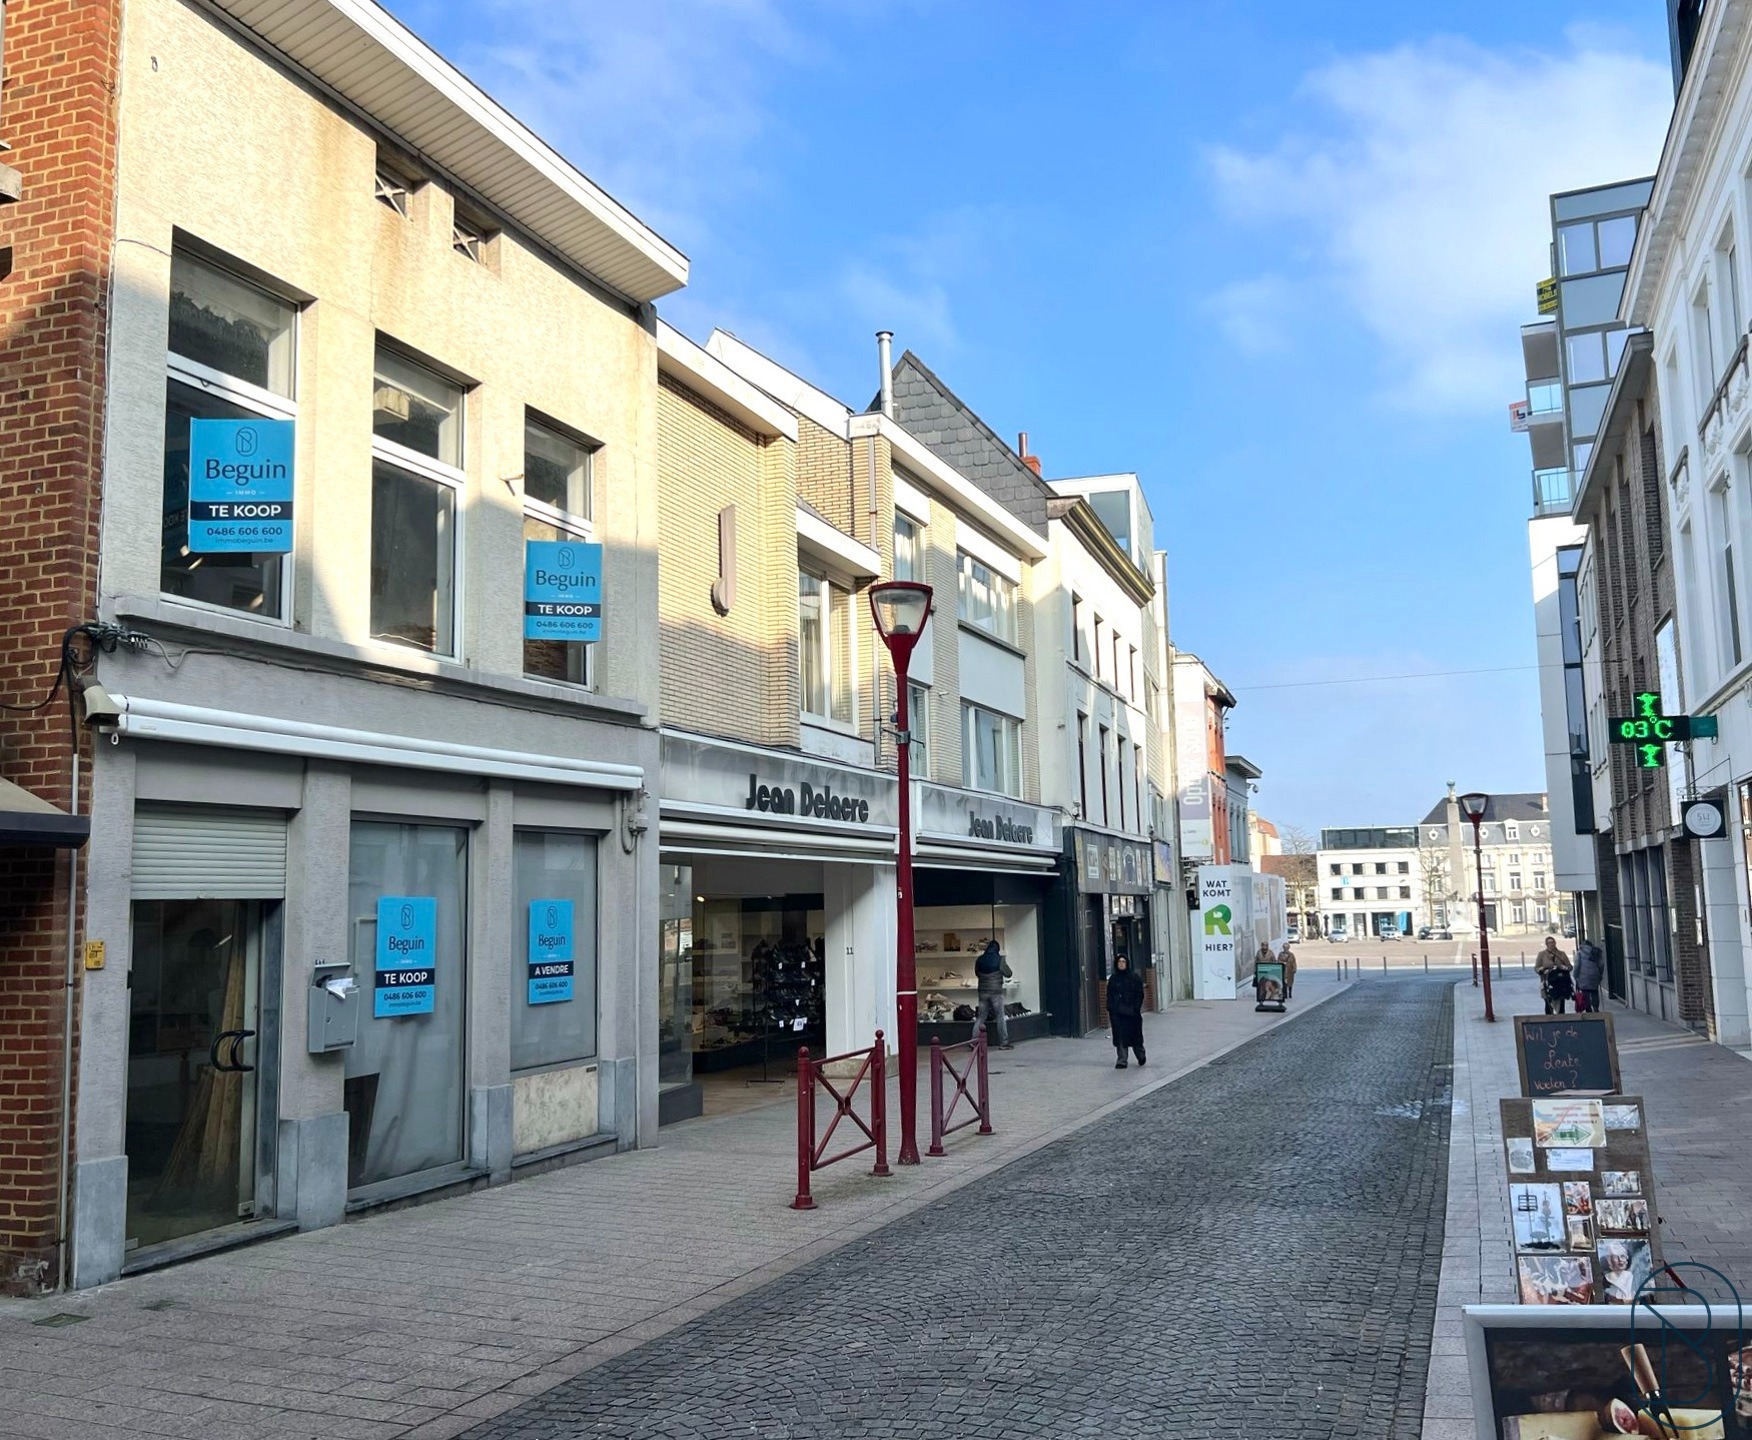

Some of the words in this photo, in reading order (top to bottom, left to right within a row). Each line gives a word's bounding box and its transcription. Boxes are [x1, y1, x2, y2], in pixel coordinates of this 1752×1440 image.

[206, 458, 286, 486] Beguin
[209, 505, 229, 517] TE
[234, 505, 281, 517] KOOP
[207, 527, 236, 536] 0486
[238, 527, 259, 536] 606
[262, 526, 283, 535] 600
[535, 569, 596, 591] Beguin
[538, 604, 553, 615] TE
[556, 605, 593, 615] KOOP
[560, 621, 576, 629] 606
[577, 622, 594, 630] 600
[745, 773, 795, 815] Jean
[800, 782, 869, 823] Delaere
[968, 811, 994, 840] Jean
[1206, 880, 1228, 888] WAT
[1202, 889, 1232, 897] KOMT
[388, 936, 425, 955] Beguin
[538, 934, 566, 950] Beguin
[1205, 943, 1233, 952] HIER?
[535, 966, 541, 976] A
[541, 964, 569, 975] VENDRE
[384, 973, 397, 984] TE
[400, 972, 428, 984] KOOP
[383, 992, 401, 1001] 0486
[402, 991, 414, 1000] 606
[415, 991, 427, 999] 600
[1548, 1030, 1560, 1048] je
